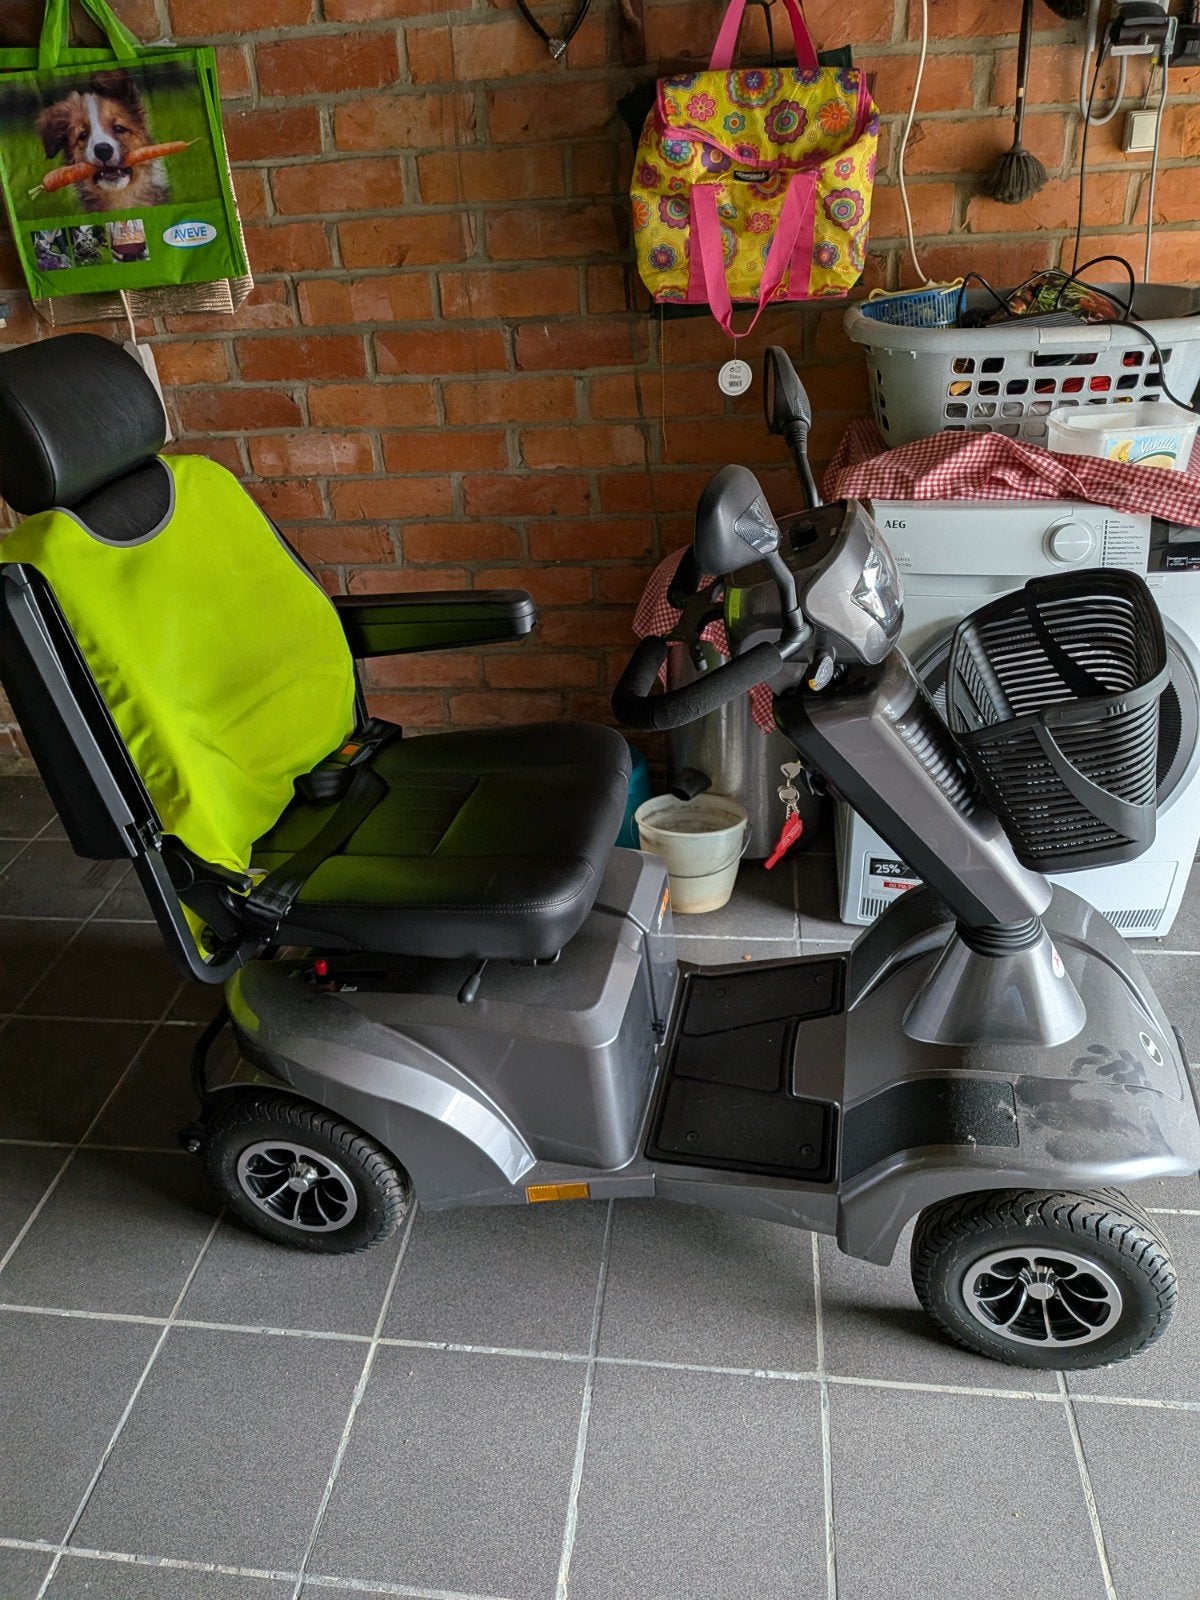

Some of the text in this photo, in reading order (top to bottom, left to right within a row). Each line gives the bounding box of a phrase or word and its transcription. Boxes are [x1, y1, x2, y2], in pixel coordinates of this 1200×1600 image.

[174, 226, 207, 242] AVEVE
[1141, 437, 1177, 455] Vanille
[884, 519, 906, 529] AEG
[875, 863, 901, 874] 25%
